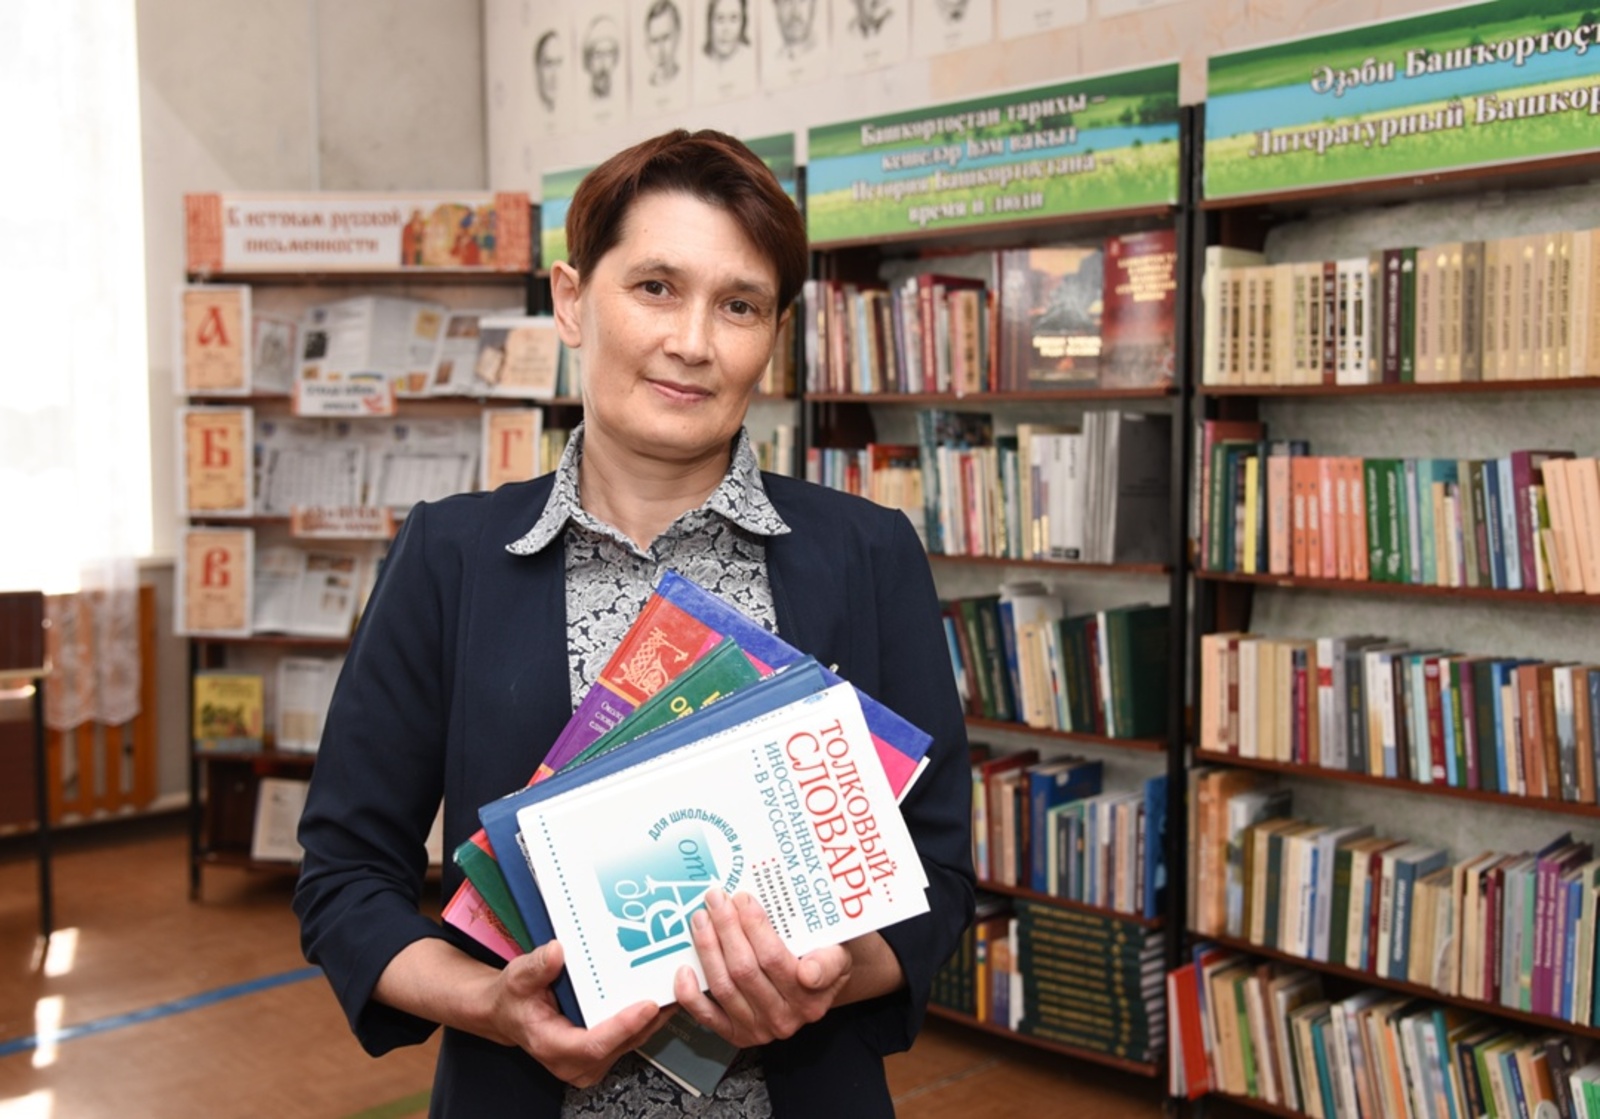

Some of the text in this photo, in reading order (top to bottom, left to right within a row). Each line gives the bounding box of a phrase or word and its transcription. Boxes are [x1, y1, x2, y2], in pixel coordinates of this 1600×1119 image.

[1006, 92, 1087, 126] тарихы
[1250, 102, 1465, 157] Литературный
[852, 180, 930, 204] История
[934, 154, 1096, 191] Башкортостана
[246, 211, 326, 228] истокам
[331, 208, 402, 235] русской
[908, 191, 1045, 227] время и люди
[245, 237, 379, 254] письменности
[195, 305, 232, 348] А
[201, 427, 230, 469] Б
[499, 428, 524, 470] Г
[201, 547, 230, 590] В
[819, 718, 898, 885] ТОЛКОВЫЙ
[648, 817, 669, 841] ДЛЯ
[668, 808, 738, 843] ШКОЛЬНИКОВ
[731, 843, 743, 853] И
[764, 741, 841, 926] ИНОСТРАННЫХ СЛОВ
[785, 731, 873, 919] СЛОВАРЬ
[754, 770, 823, 933] В РУССКОМ ЯЗЫКЕ
